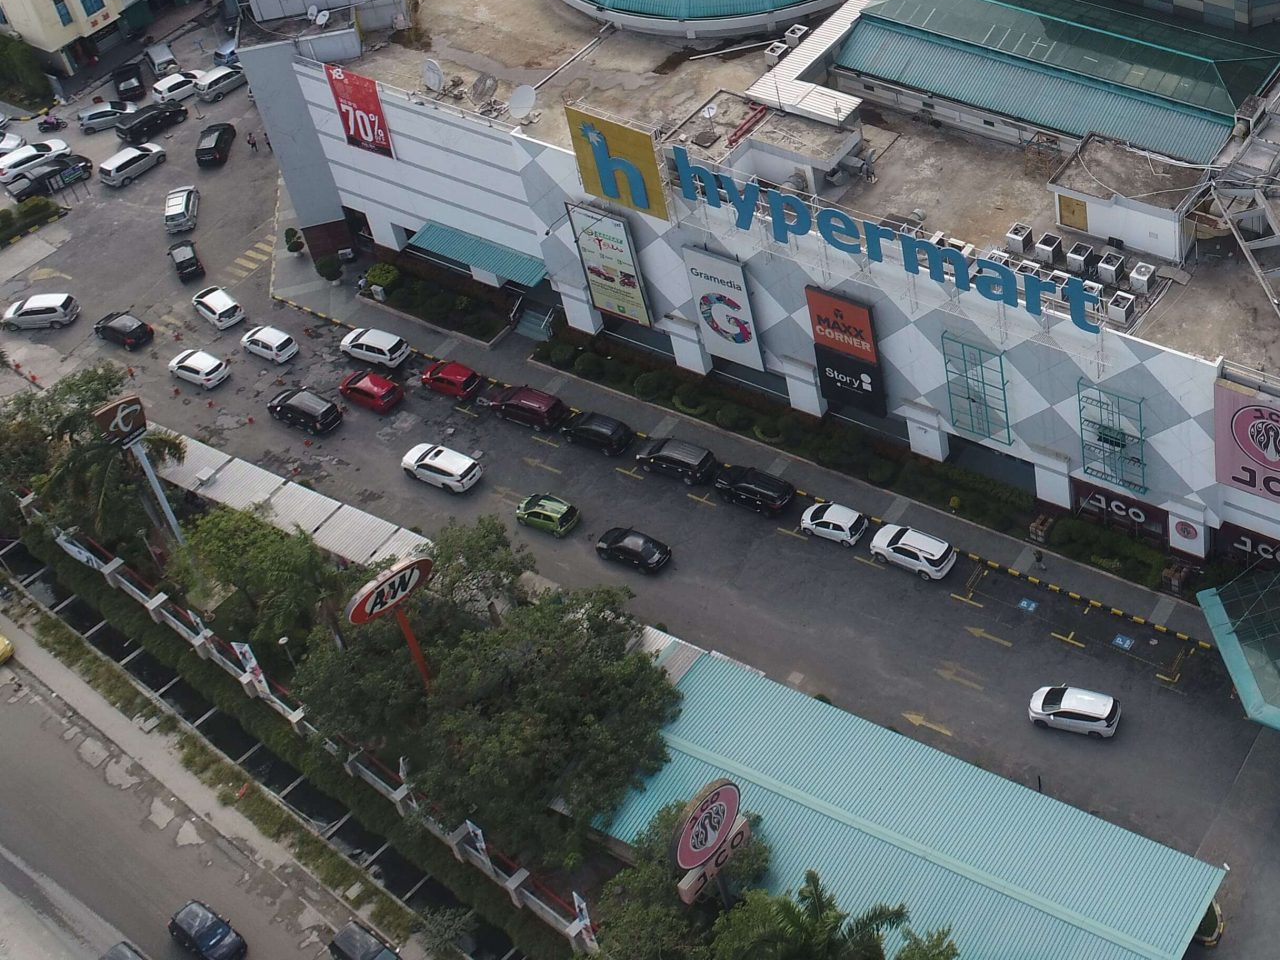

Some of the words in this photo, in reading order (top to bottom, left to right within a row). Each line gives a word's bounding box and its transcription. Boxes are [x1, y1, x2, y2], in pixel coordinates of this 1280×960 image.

[340, 102, 385, 142] 70%
[672, 144, 1100, 335] hypermart
[690, 267, 743, 292] Gramedia
[815, 325, 871, 352] CORNER
[816, 314, 866, 340] MAXX
[1089, 493, 1146, 523] J.CO
[368, 565, 417, 617] A&W
[694, 830, 745, 896] J.CO
